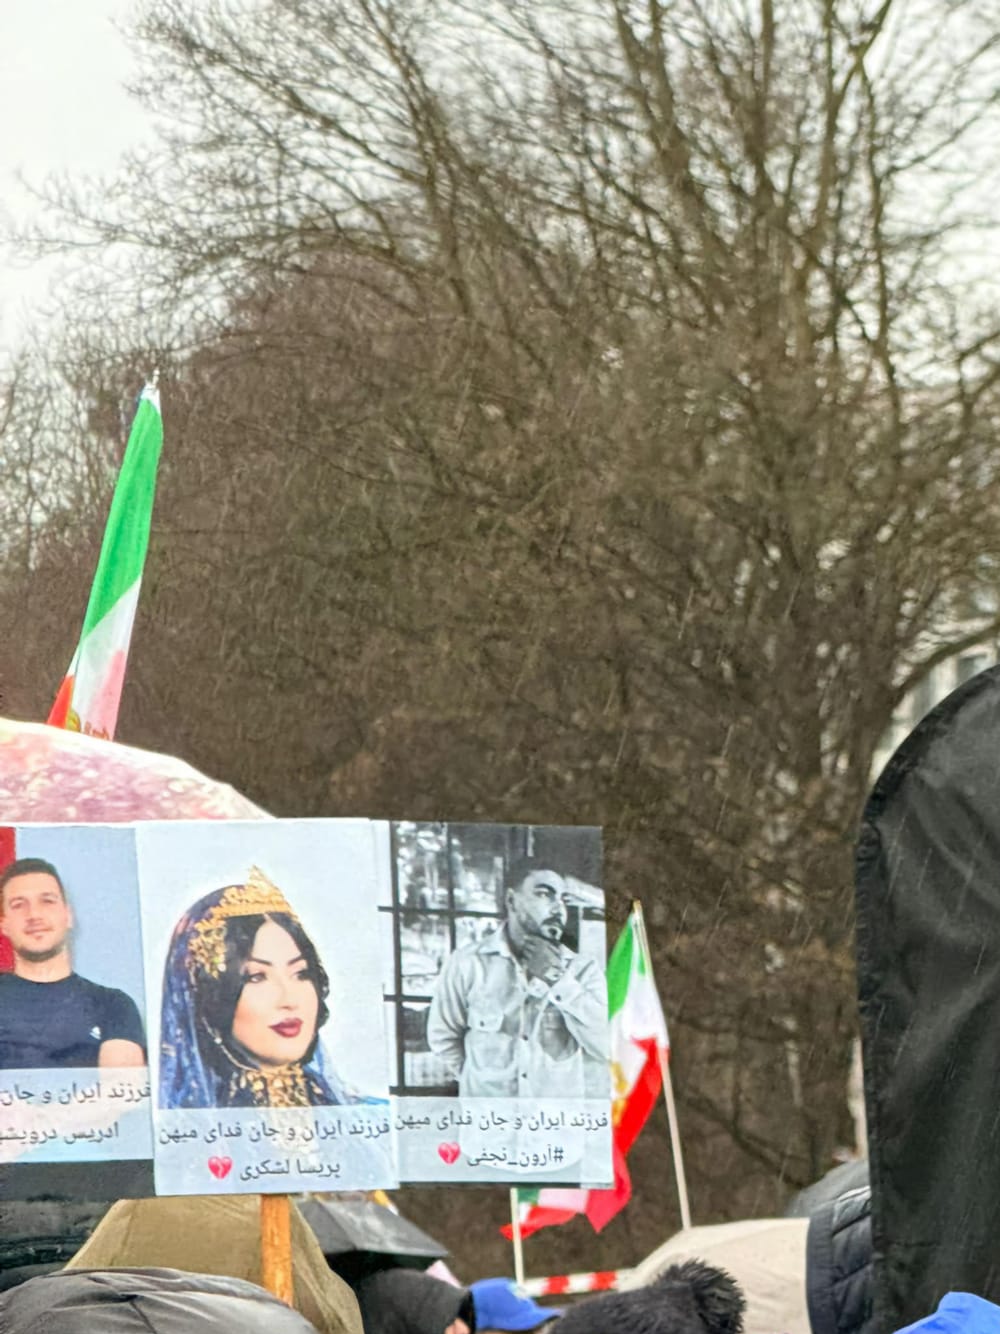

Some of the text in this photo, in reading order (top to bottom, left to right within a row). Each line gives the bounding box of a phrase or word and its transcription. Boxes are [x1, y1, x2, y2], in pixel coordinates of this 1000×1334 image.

[41, 1090, 52, 1104] و
[58, 1082, 101, 1105] ایران
[107, 1081, 151, 1102] فرزند
[159, 1118, 391, 1145] فرزند ایران و جان فدای میهن
[395, 1110, 608, 1131] فرزند ایران و جان فدای میهن
[0, 1121, 119, 1145] ادریس درویش
